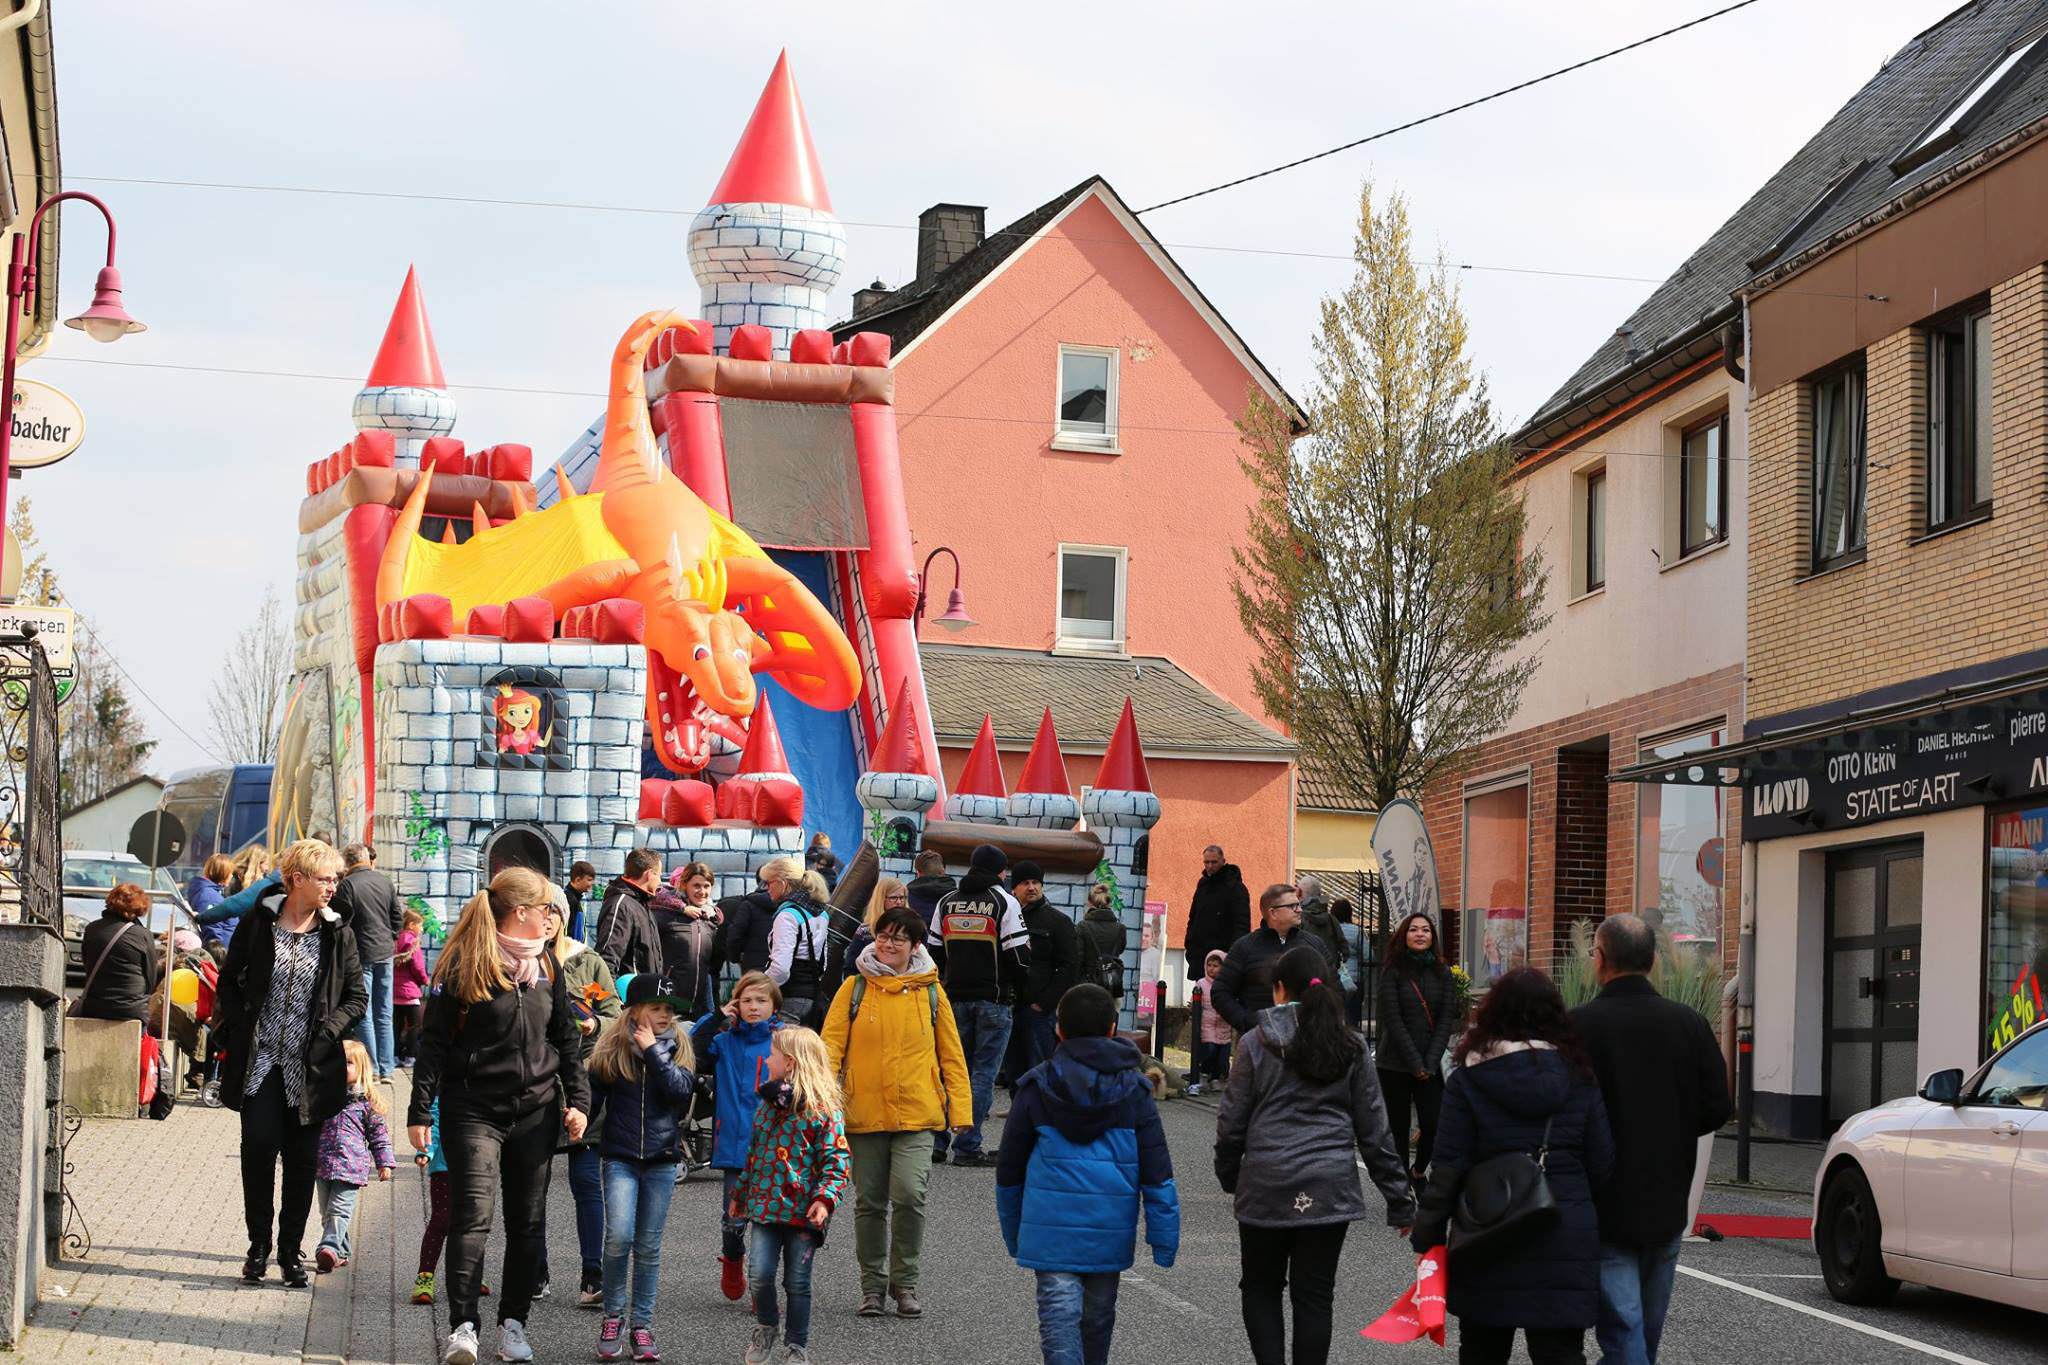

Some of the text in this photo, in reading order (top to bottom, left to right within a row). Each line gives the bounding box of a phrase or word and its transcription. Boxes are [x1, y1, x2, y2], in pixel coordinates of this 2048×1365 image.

[10, 412, 71, 443] bacher
[0, 616, 66, 634] rkten
[1918, 732, 1950, 754] DANIEL
[2010, 710, 2046, 746] pierre
[1828, 744, 1897, 784] OTTO KERN
[1945, 751, 1968, 761] PARIS
[1753, 777, 1810, 816] LLOYD
[1846, 771, 1961, 820] STATE OF ART
[945, 900, 994, 916] TEAM
